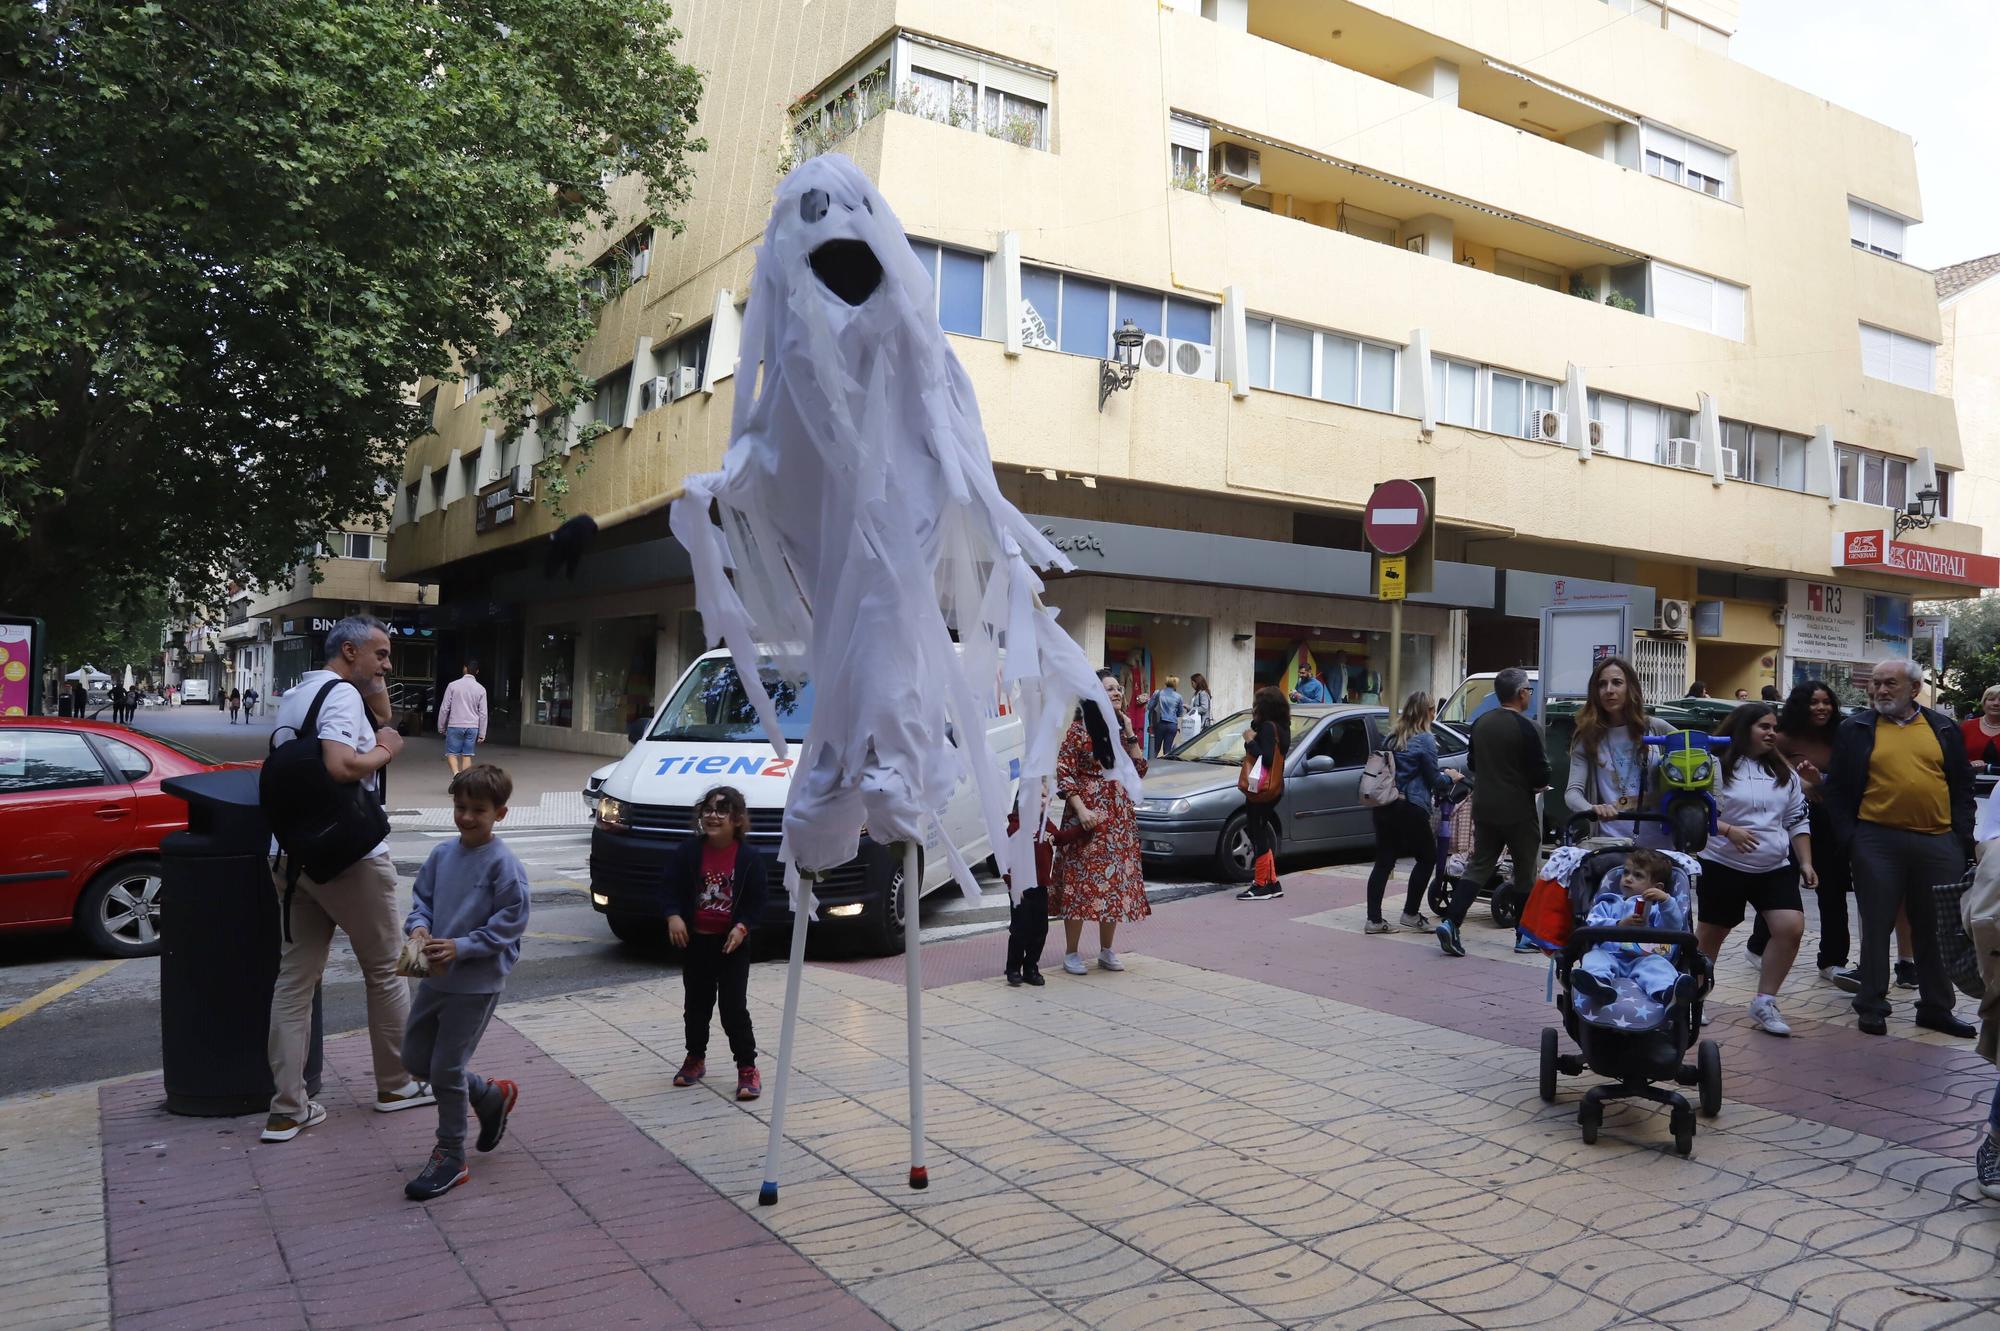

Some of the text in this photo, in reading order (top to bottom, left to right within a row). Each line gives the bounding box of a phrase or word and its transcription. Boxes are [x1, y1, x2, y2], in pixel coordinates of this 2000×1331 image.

[1025, 305, 1052, 346] VENDO
[1907, 549, 1967, 578] GENERALI
[1825, 585, 1842, 614] R3
